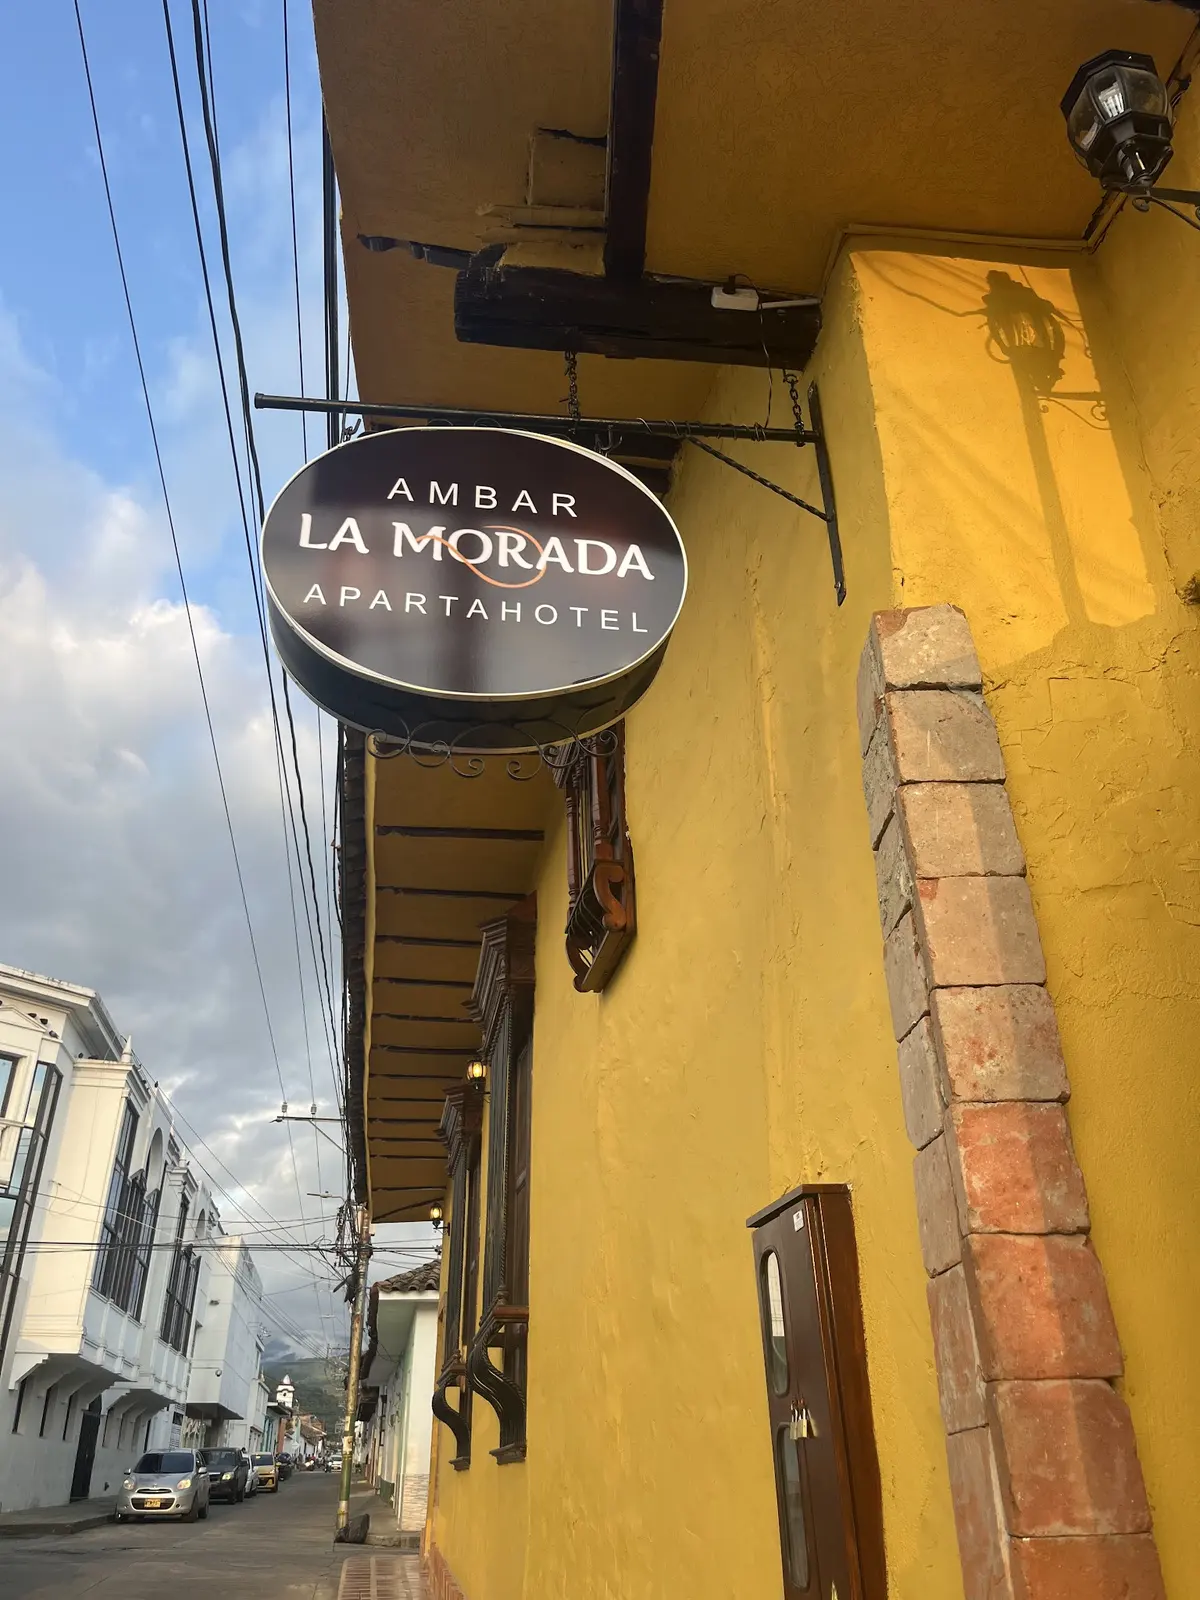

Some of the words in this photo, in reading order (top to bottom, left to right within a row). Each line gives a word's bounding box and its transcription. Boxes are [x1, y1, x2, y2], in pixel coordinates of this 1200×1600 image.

[387, 477, 578, 518] AMBAR
[299, 513, 370, 554] LA
[391, 521, 655, 581] MORADA
[303, 583, 648, 633] APARTAHOTEL
